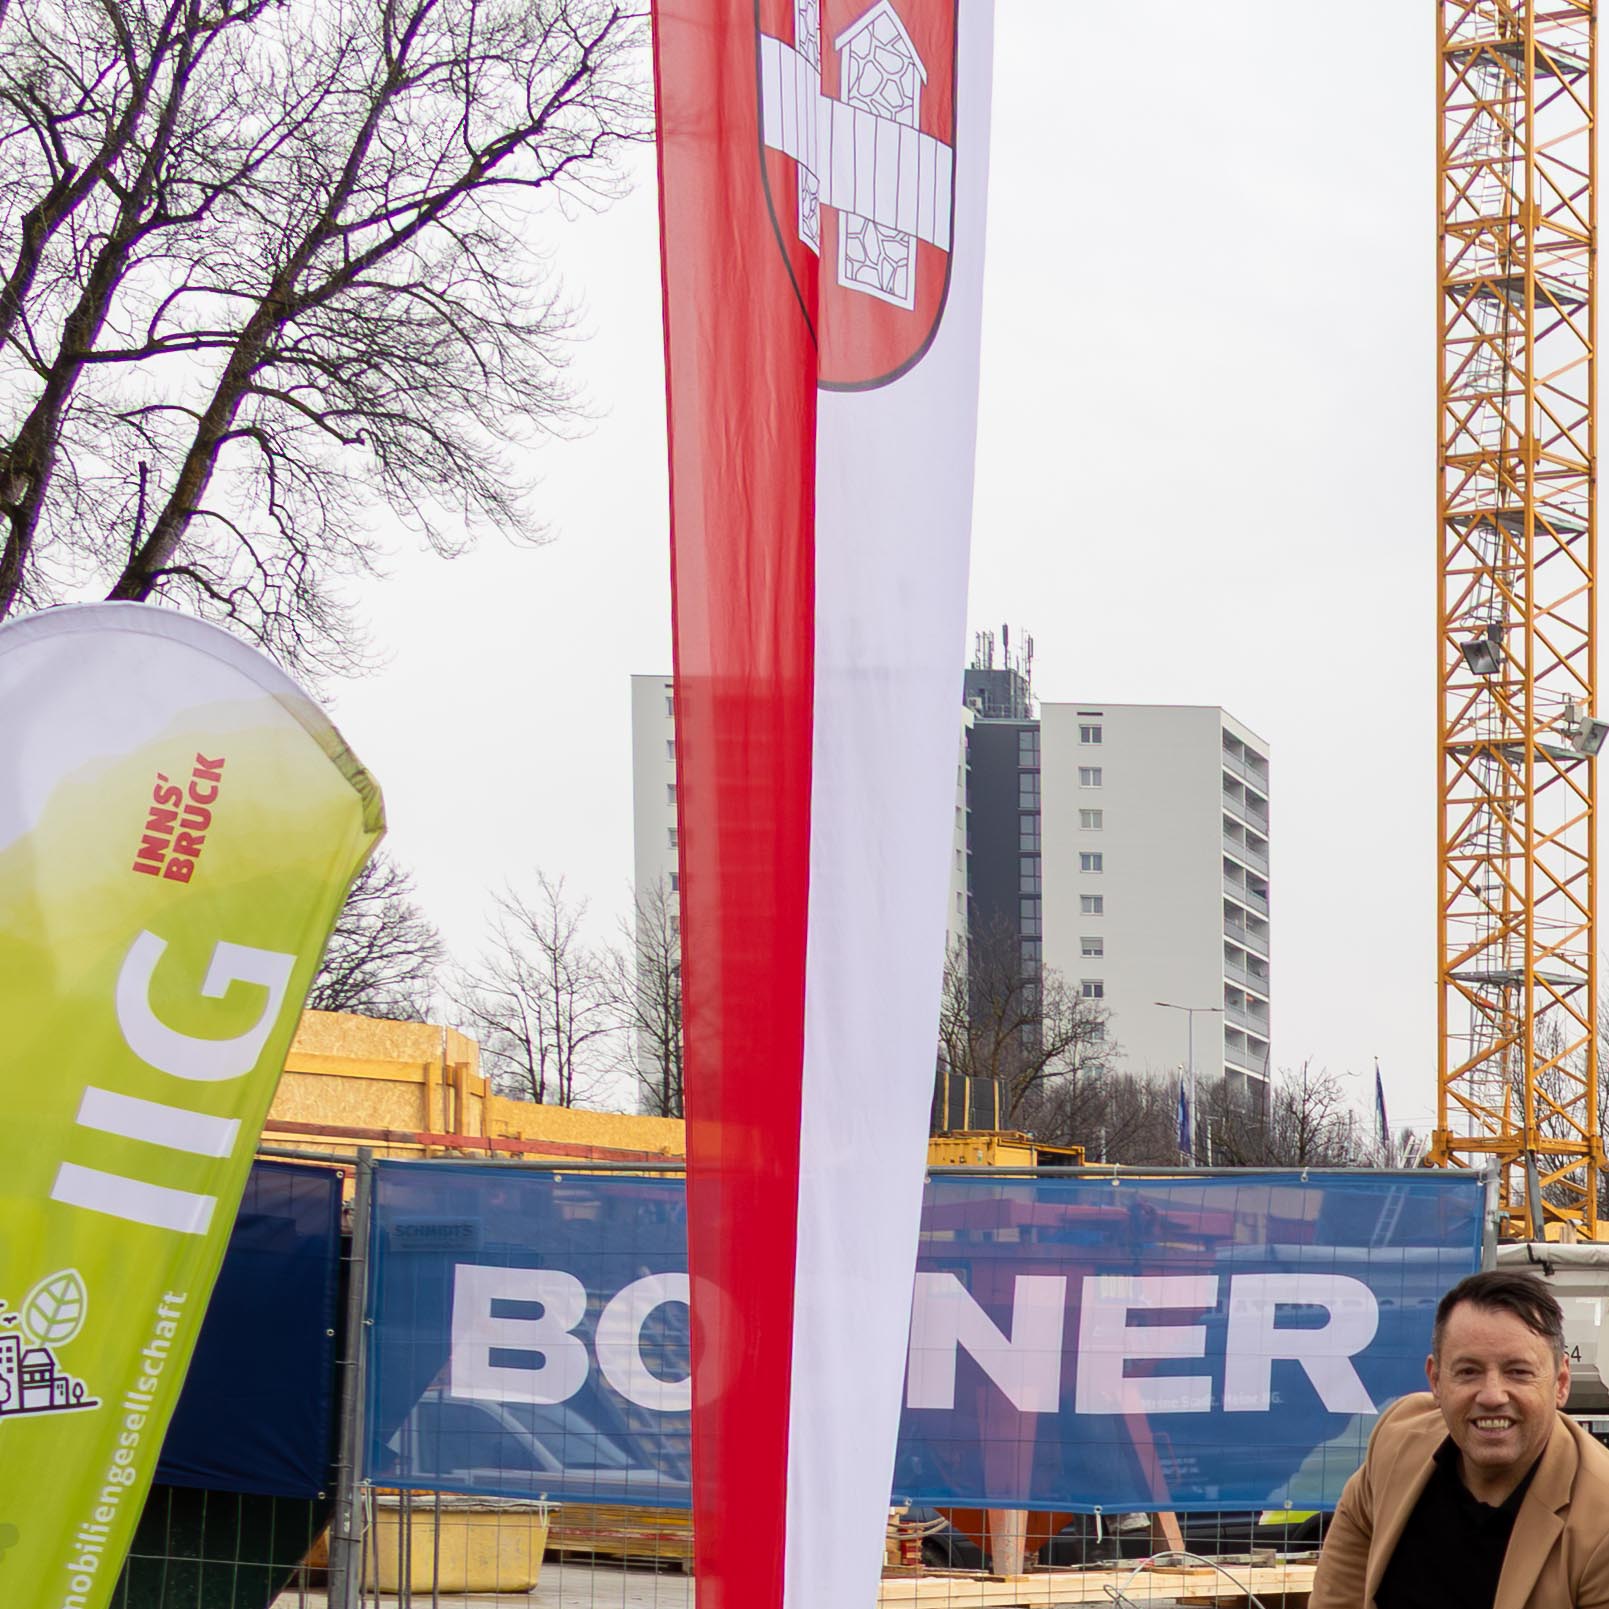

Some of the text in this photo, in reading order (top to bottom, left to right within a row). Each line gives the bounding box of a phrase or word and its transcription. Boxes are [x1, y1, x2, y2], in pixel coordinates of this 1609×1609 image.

[163, 752, 225, 884] BRUCK
[50, 929, 297, 1236] IIG
[451, 1263, 1379, 1414] BONER
